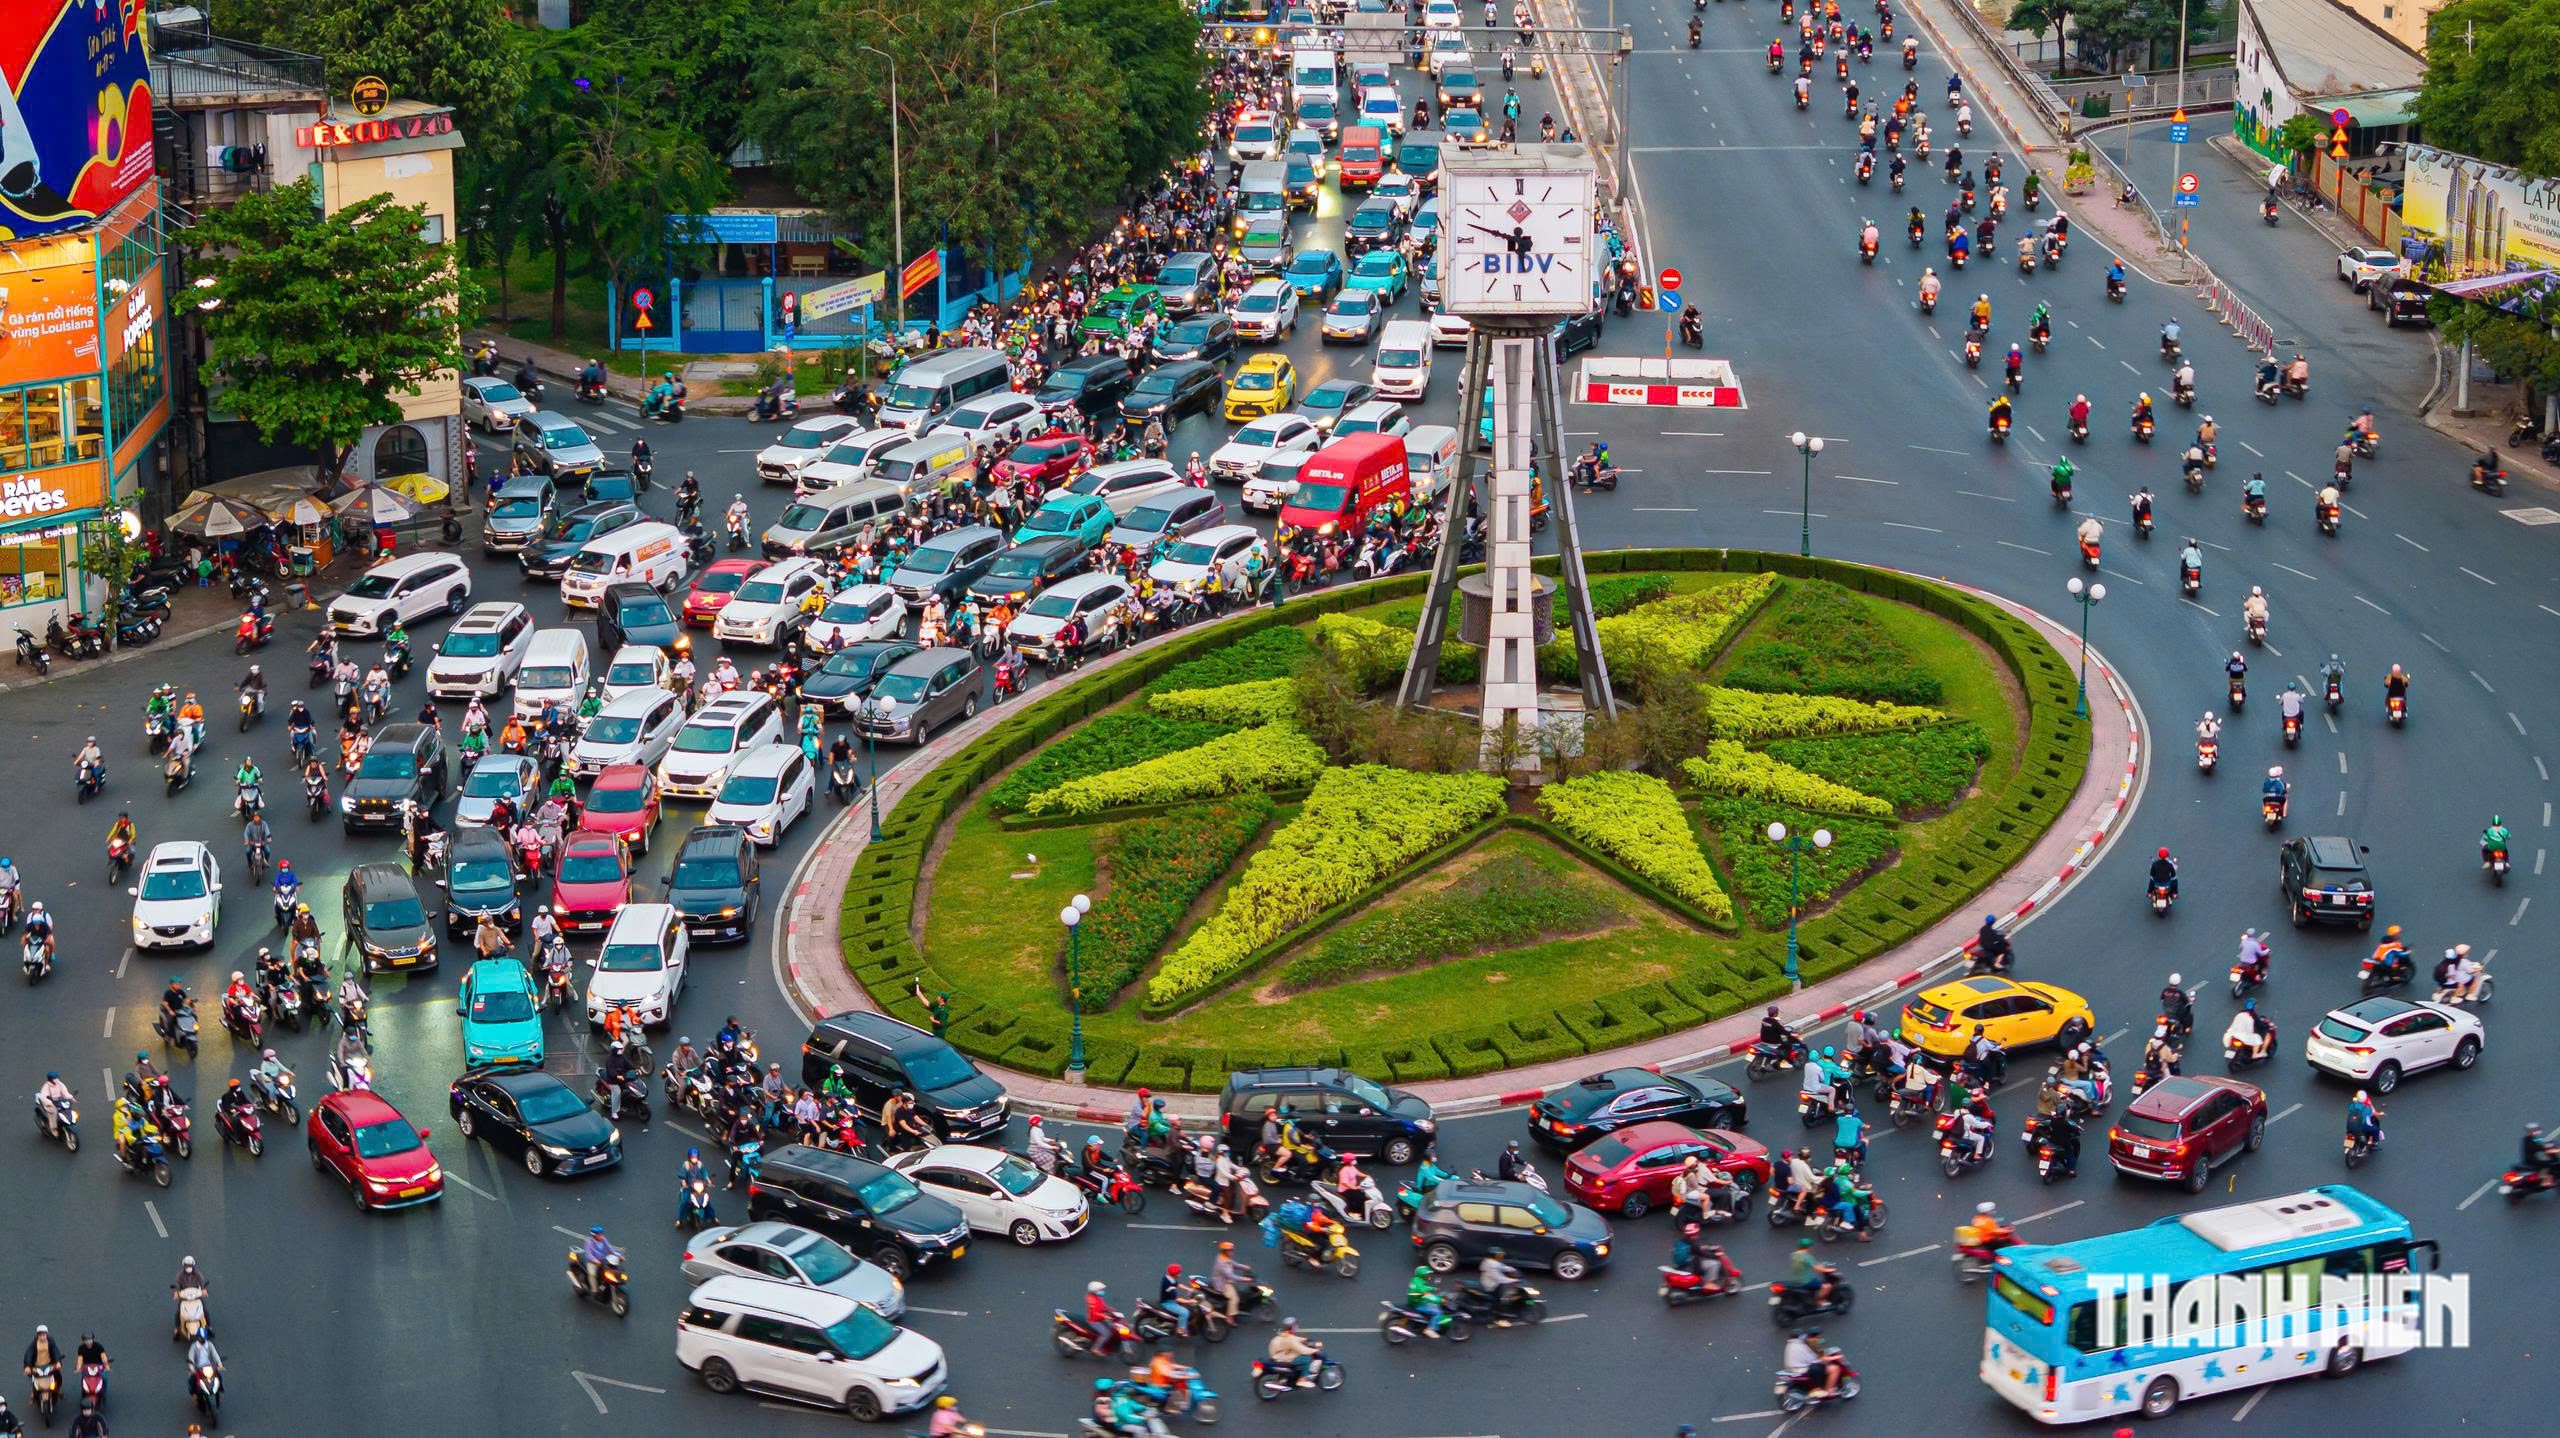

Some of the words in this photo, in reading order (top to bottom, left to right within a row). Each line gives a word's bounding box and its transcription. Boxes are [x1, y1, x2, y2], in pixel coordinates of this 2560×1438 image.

[332, 123, 352, 146] &
[407, 113, 453, 138] 245
[2523, 184, 2543, 208] LA
[1484, 253, 1554, 273] BIDV
[8, 312, 24, 325] Gà
[25, 311, 45, 323] rán
[65, 303, 94, 317] tiếng
[10, 326, 40, 339] vùng
[40, 318, 94, 335] Louisiana
[2, 474, 42, 497] RÁN
[44, 526, 78, 539] CHICKEN
